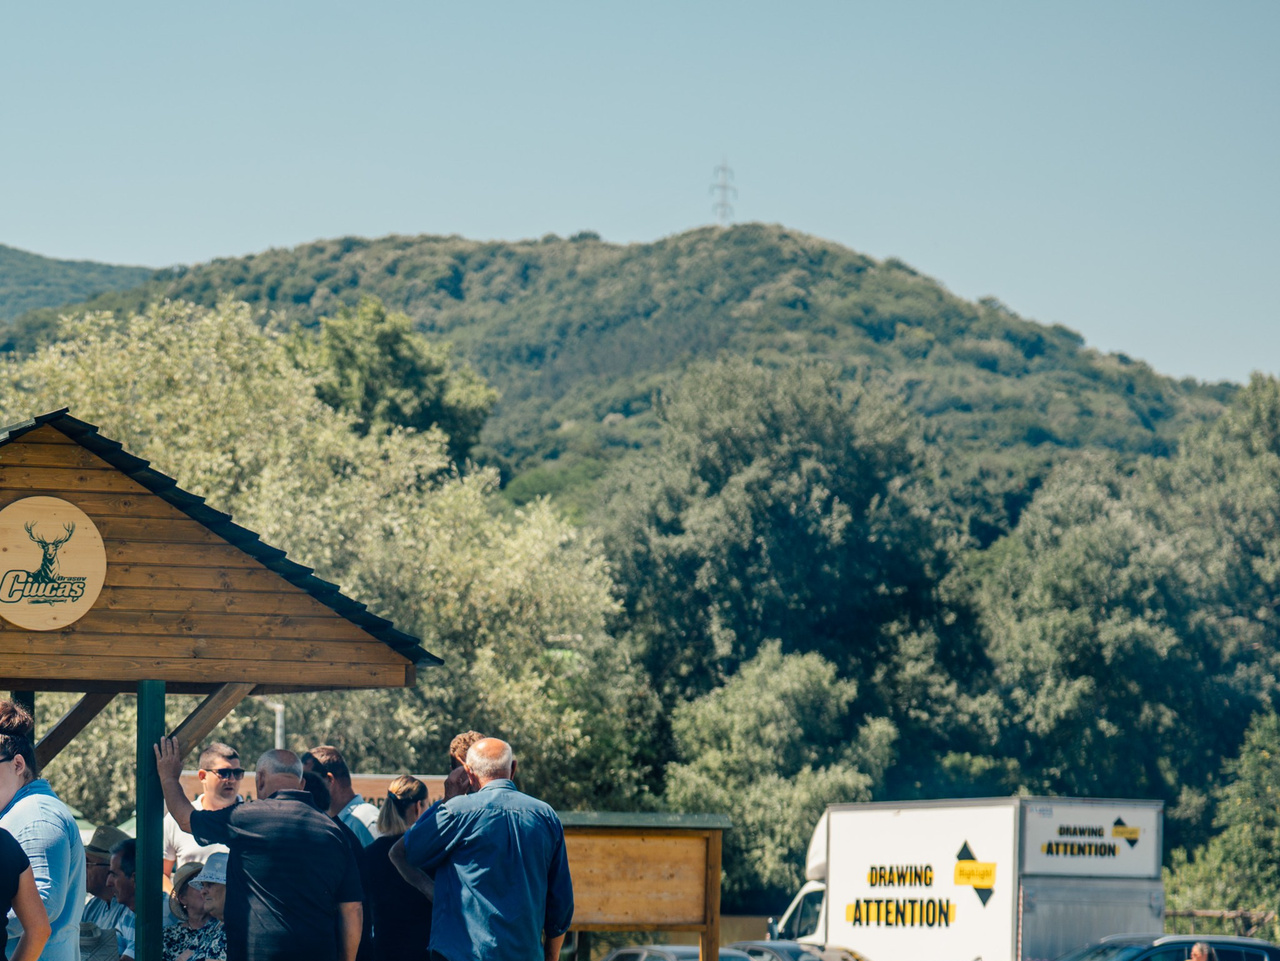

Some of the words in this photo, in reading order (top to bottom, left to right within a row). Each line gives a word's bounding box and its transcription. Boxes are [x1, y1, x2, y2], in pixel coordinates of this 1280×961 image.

[1058, 825, 1104, 837] DRAWING
[1046, 842, 1116, 857] ATTENTION
[870, 865, 933, 887] DRAWING
[853, 898, 950, 927] ATTENTION
